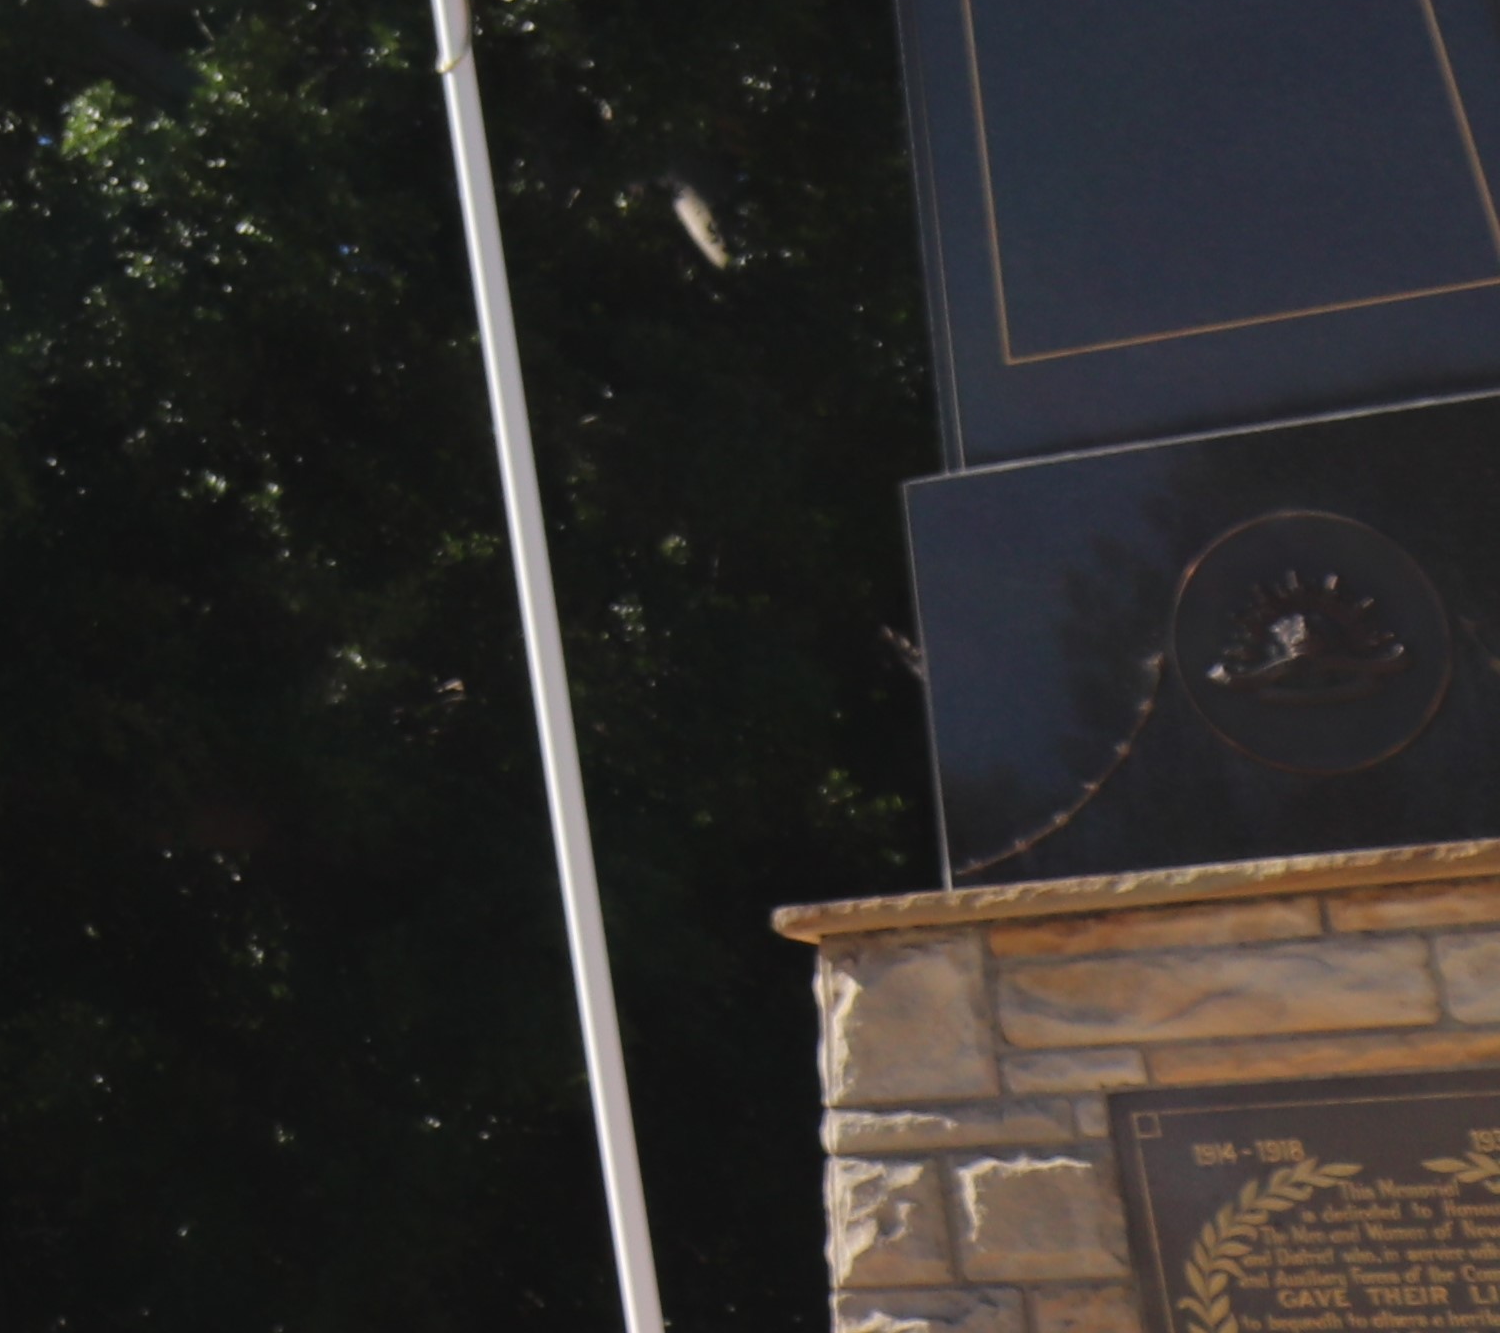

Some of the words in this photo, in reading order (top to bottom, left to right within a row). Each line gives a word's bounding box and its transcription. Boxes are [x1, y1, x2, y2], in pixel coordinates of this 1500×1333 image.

[1192, 1143, 1238, 1167] 1914
[1255, 1139, 1305, 1163] 1918
[1377, 1176, 1460, 1202] Memorial
[1323, 1203, 1401, 1224] dedicated
[1410, 1201, 1433, 1220] to
[1329, 1224, 1360, 1245] and
[1363, 1222, 1428, 1242] Women
[1434, 1219, 1454, 1240] of
[1276, 1247, 1335, 1267] District
[1406, 1246, 1465, 1262] service
[1275, 1269, 1348, 1291] Auxiliary
[1350, 1265, 1401, 1285] Forces
[1404, 1263, 1422, 1284] of
[1427, 1264, 1457, 1284] the
[1277, 1287, 1352, 1309] GAVE
[1364, 1284, 1449, 1307] THEIR
[1467, 1284, 1500, 1305] LI
[1241, 1313, 1263, 1331] to
[1345, 1310, 1369, 1330] to
